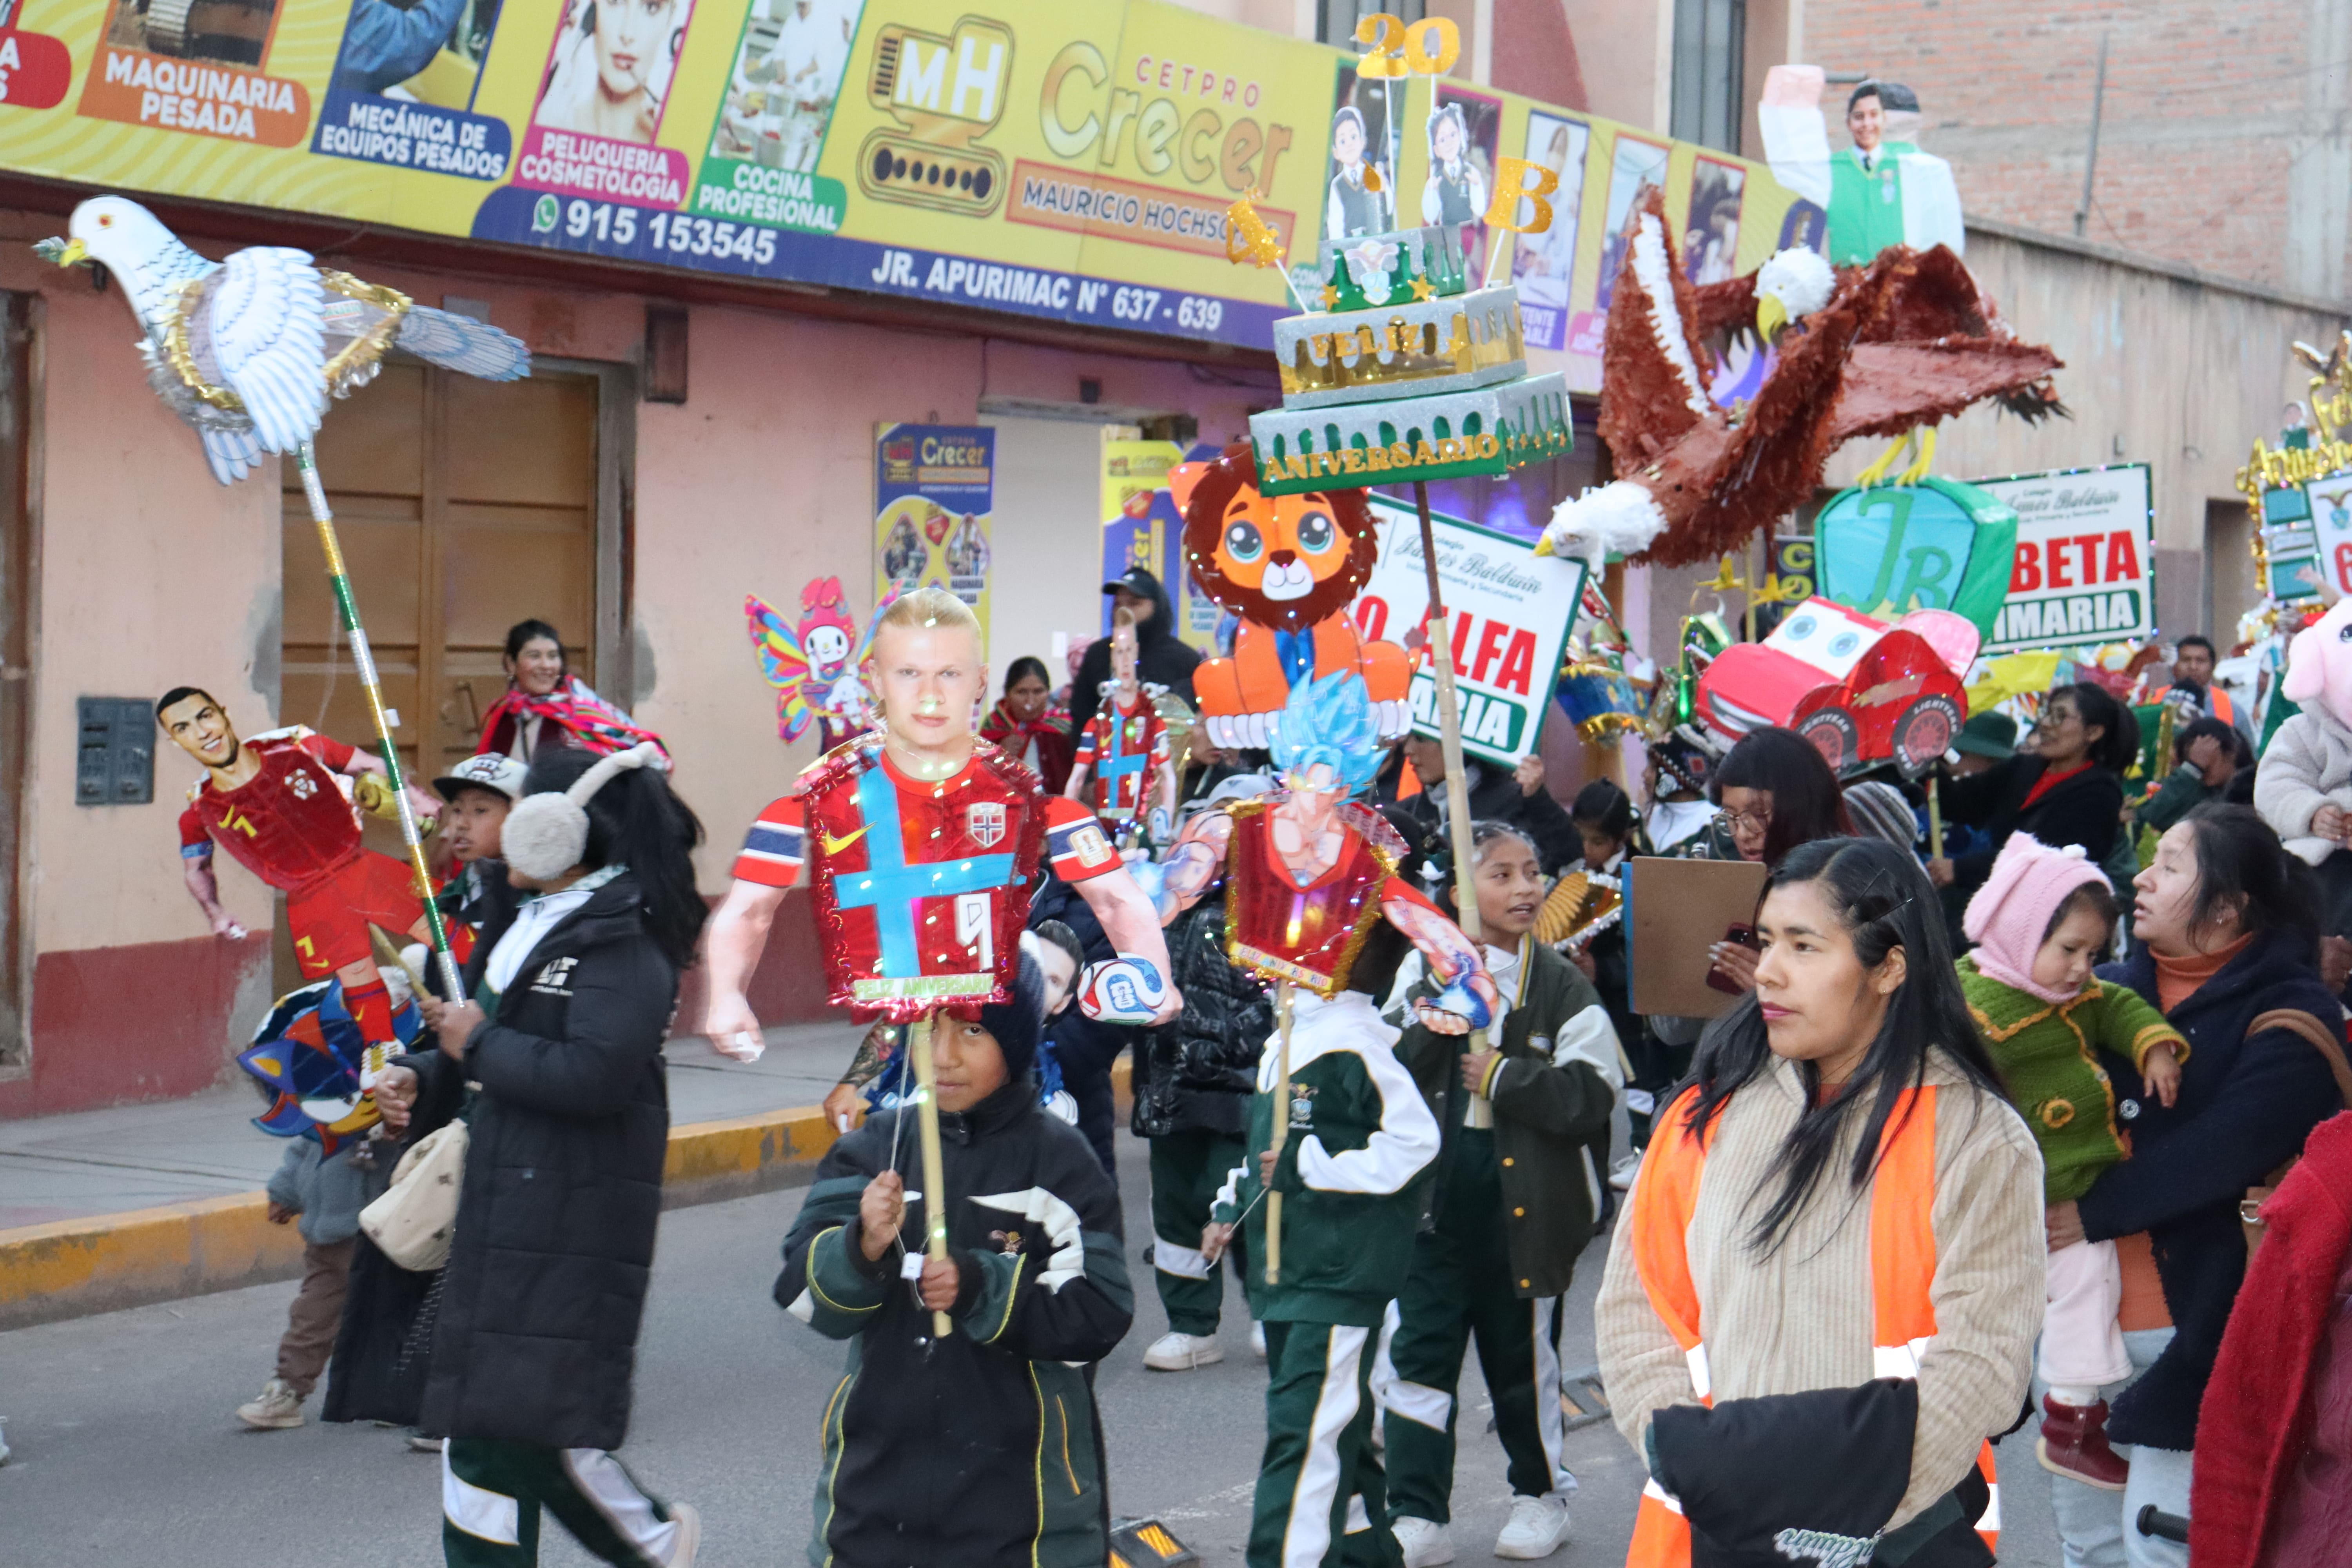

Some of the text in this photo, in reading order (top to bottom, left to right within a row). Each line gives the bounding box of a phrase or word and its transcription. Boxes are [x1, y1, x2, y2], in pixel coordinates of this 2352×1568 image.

[1356, 13, 1460, 78] 20
[105, 52, 296, 114] MAQUINARIA
[894, 36, 1004, 122] MH
[1136, 56, 1261, 108] CETPRO
[140, 91, 256, 138] PESADA
[349, 102, 488, 151] MECÁNICA DE
[1039, 41, 1293, 198] Crecer
[320, 124, 505, 179] EQUIPOS PESADOS
[541, 132, 669, 177] PELUQUERIA
[520, 154, 681, 203] COSMETOLOGIA
[734, 164, 813, 200] COCINA
[1023, 178, 1139, 222] MAURICIO
[1483, 156, 1559, 233] B
[698, 185, 838, 231] PROFESIONAL
[566, 200, 777, 265] 915 153545
[872, 250, 918, 287] JR.
[926, 258, 1072, 310] APURIMAC
[1112, 288, 1161, 321] 637
[1178, 296, 1223, 331] 639
[1310, 324, 1425, 359] FELIZ
[921, 436, 985, 466] Crecer
[1263, 433, 1500, 481] ANIVERSARIO
[1460, 552, 1542, 594] Baldwin
[2008, 530, 2141, 593] BETA
[1800, 713, 1850, 735] IGHTYEAR
[1914, 699, 1957, 733] LIGHTYEAR
[232, 815, 258, 838] 7
[295, 935, 315, 957] 7
[954, 893, 993, 971] 9
[856, 974, 995, 1000] FELIZ ANIVERSARIO
